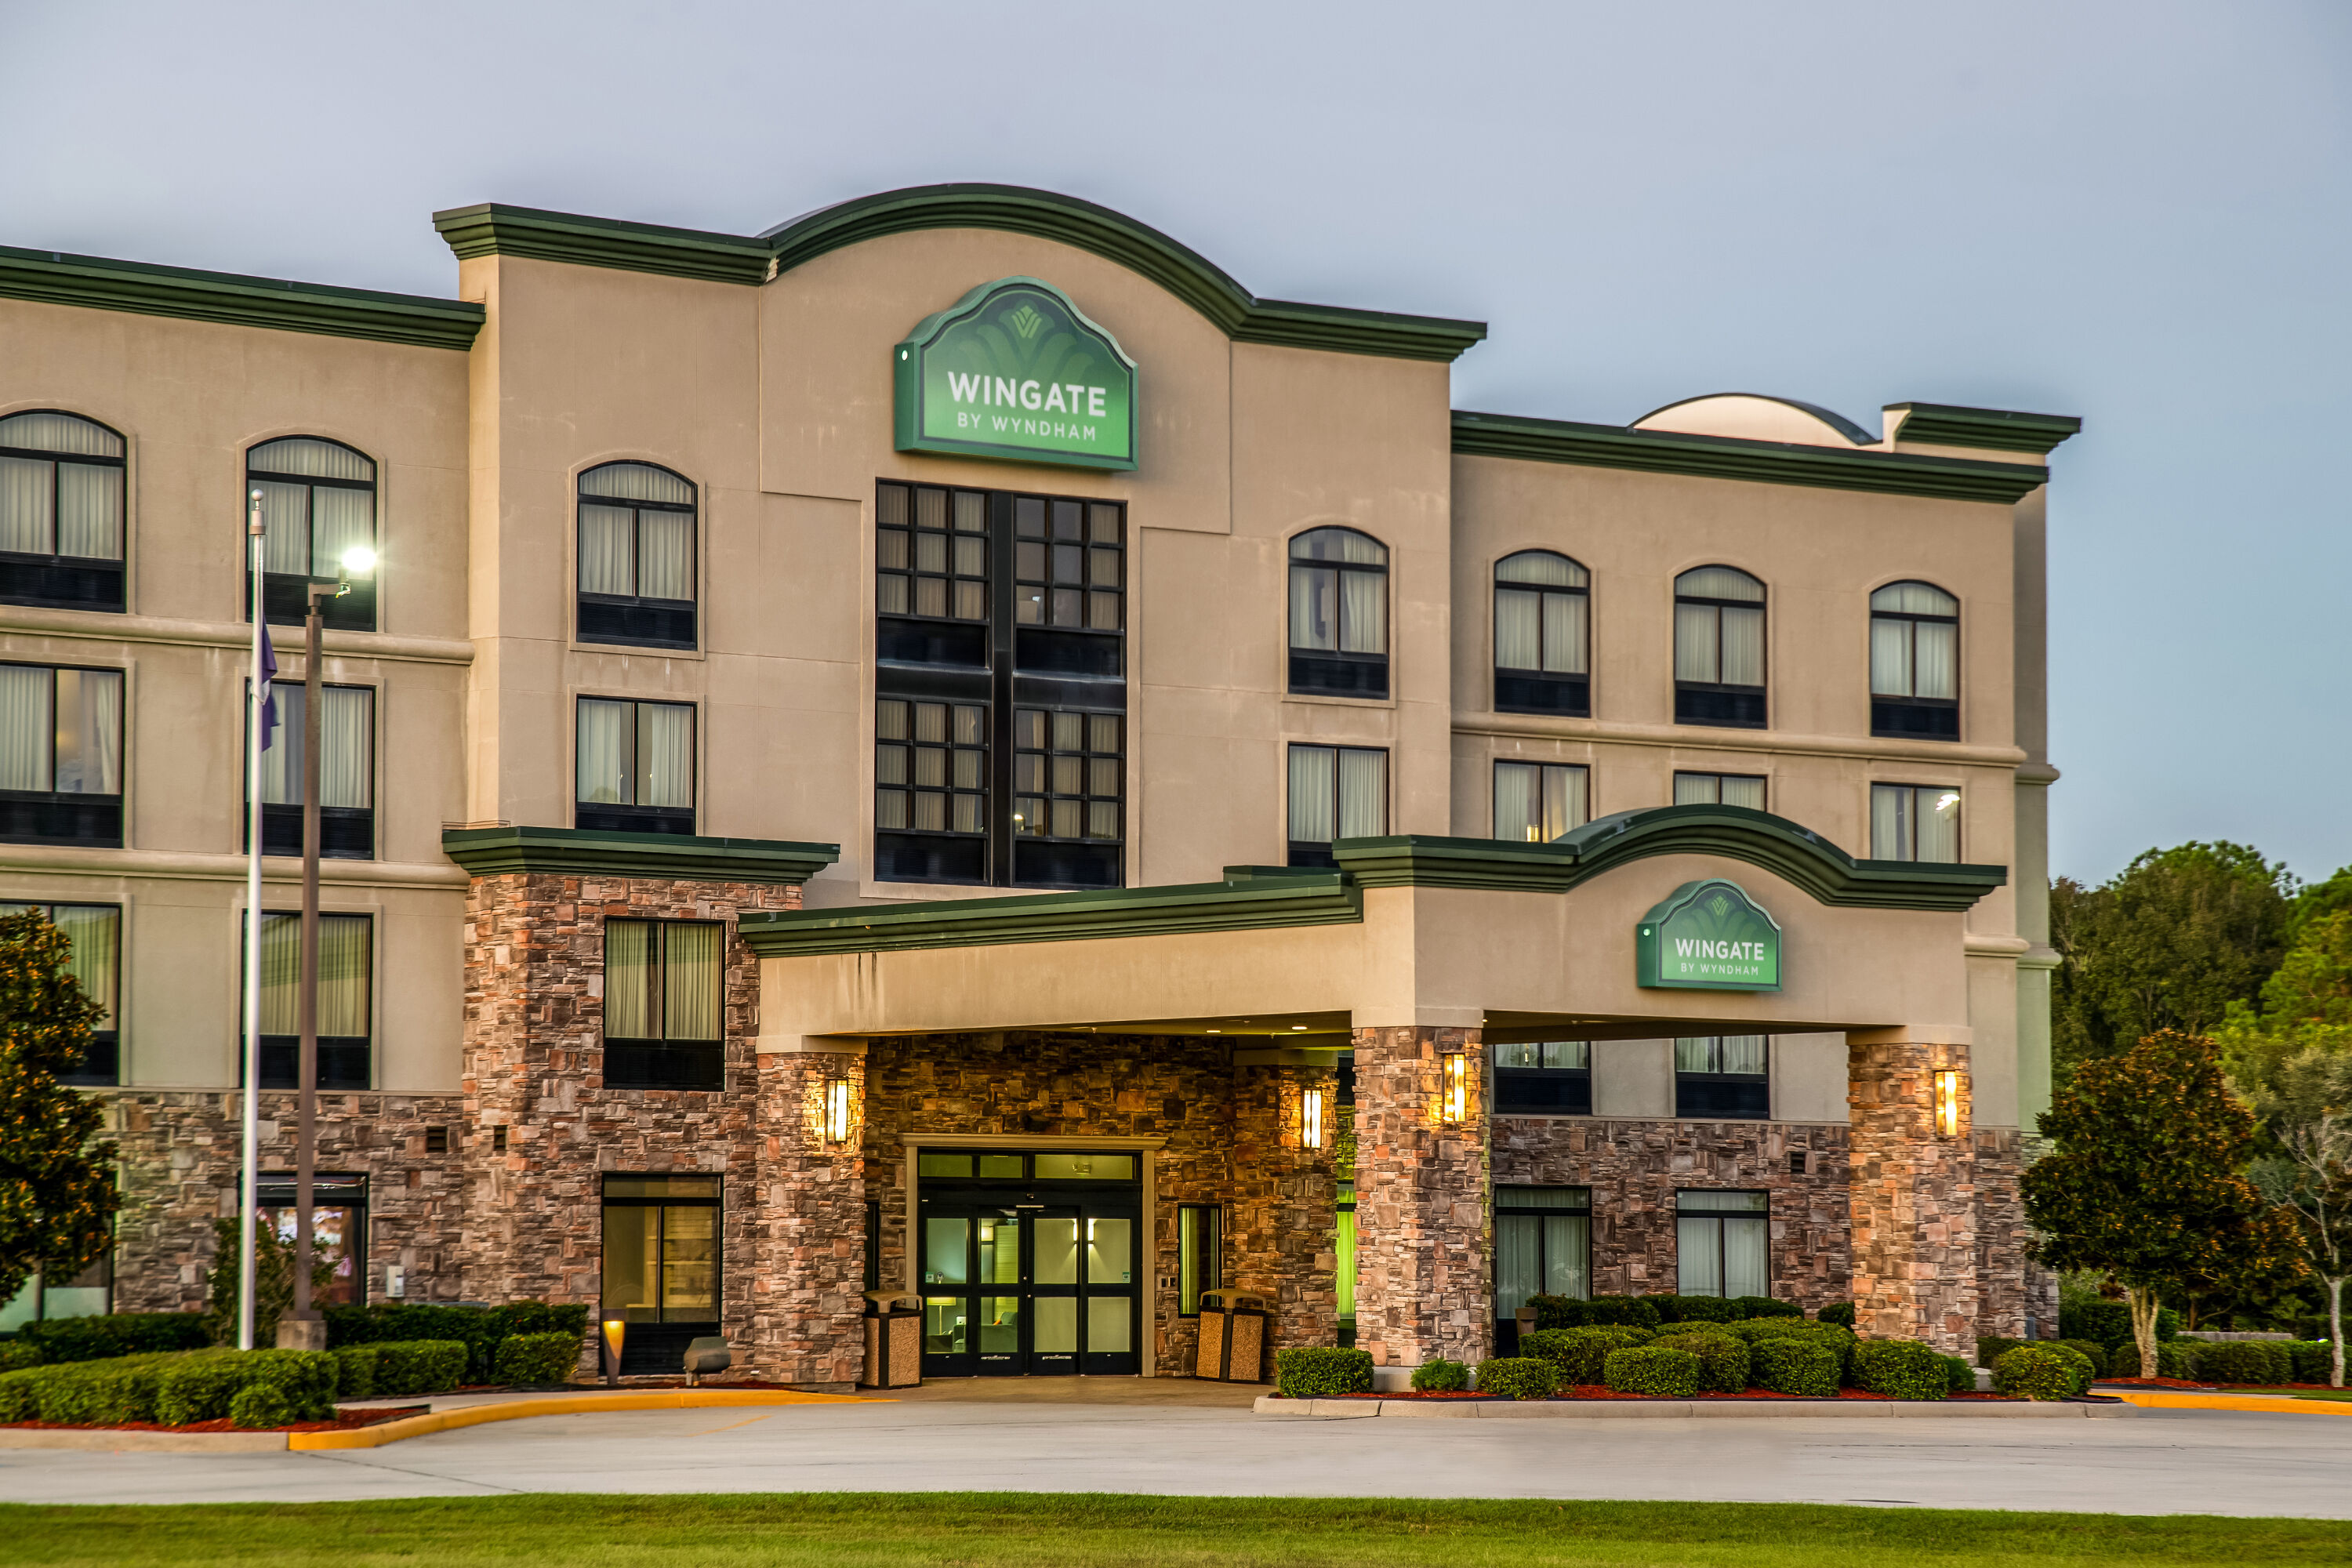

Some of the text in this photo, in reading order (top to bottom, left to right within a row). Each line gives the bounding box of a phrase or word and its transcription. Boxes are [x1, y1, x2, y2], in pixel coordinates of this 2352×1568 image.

[947, 371, 1106, 417] WINGATE
[957, 412, 1096, 441] BY WYNDHAM
[1675, 938, 1764, 960] WINGATE
[1681, 963, 1759, 975] BY WYNDHAM
